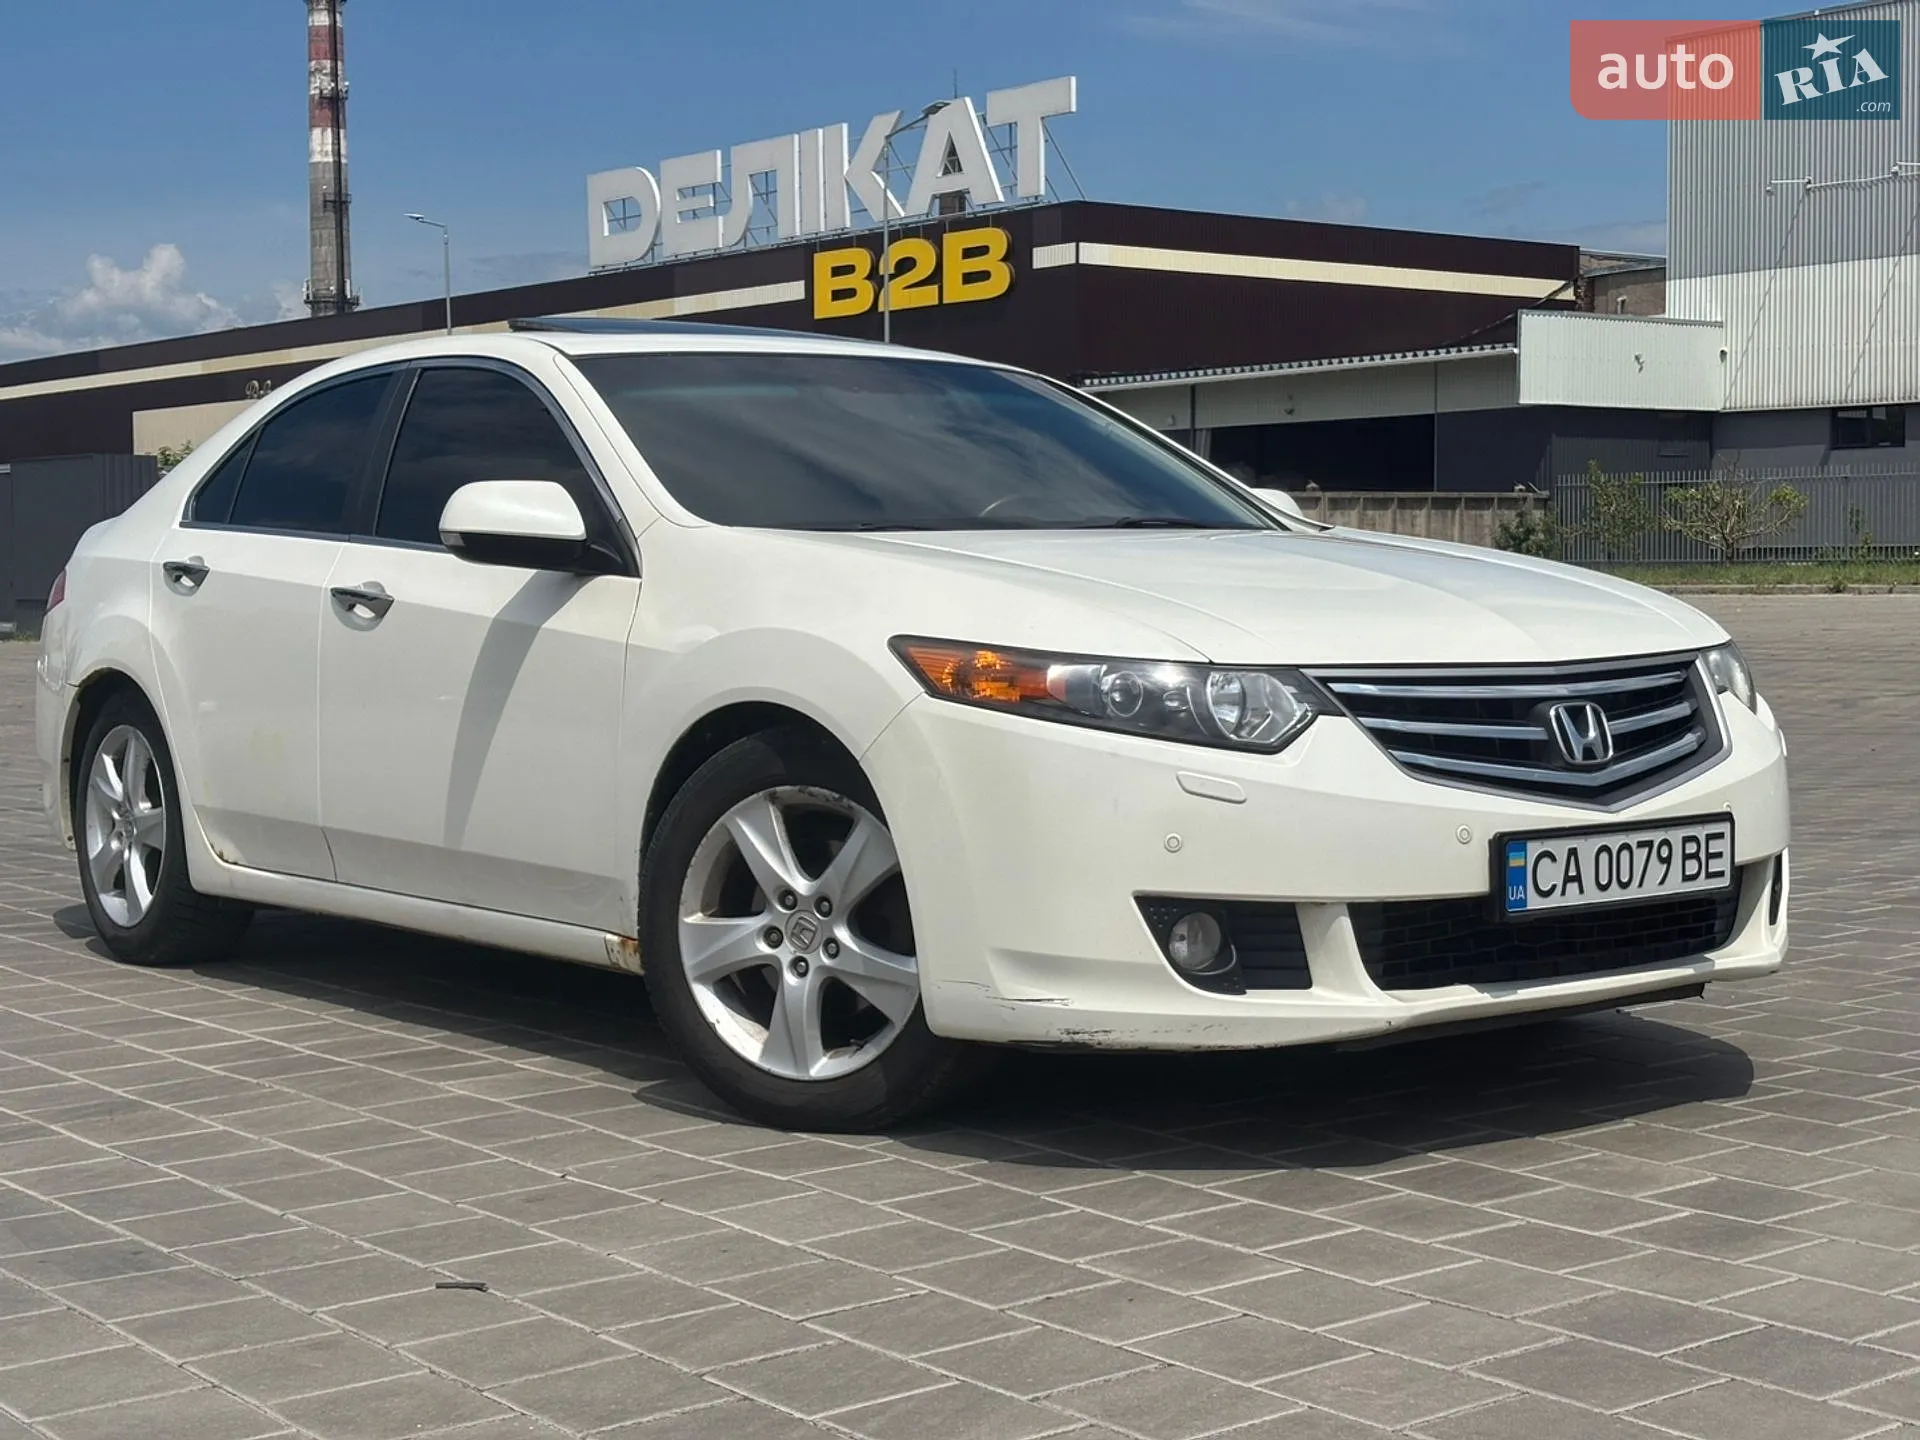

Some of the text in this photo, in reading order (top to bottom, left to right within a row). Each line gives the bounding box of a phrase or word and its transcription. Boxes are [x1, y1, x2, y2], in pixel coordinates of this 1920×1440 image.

[813, 226, 1014, 320] B2B
[1508, 885, 1525, 901] UA
[1532, 831, 1726, 899] CA 0079 BE
